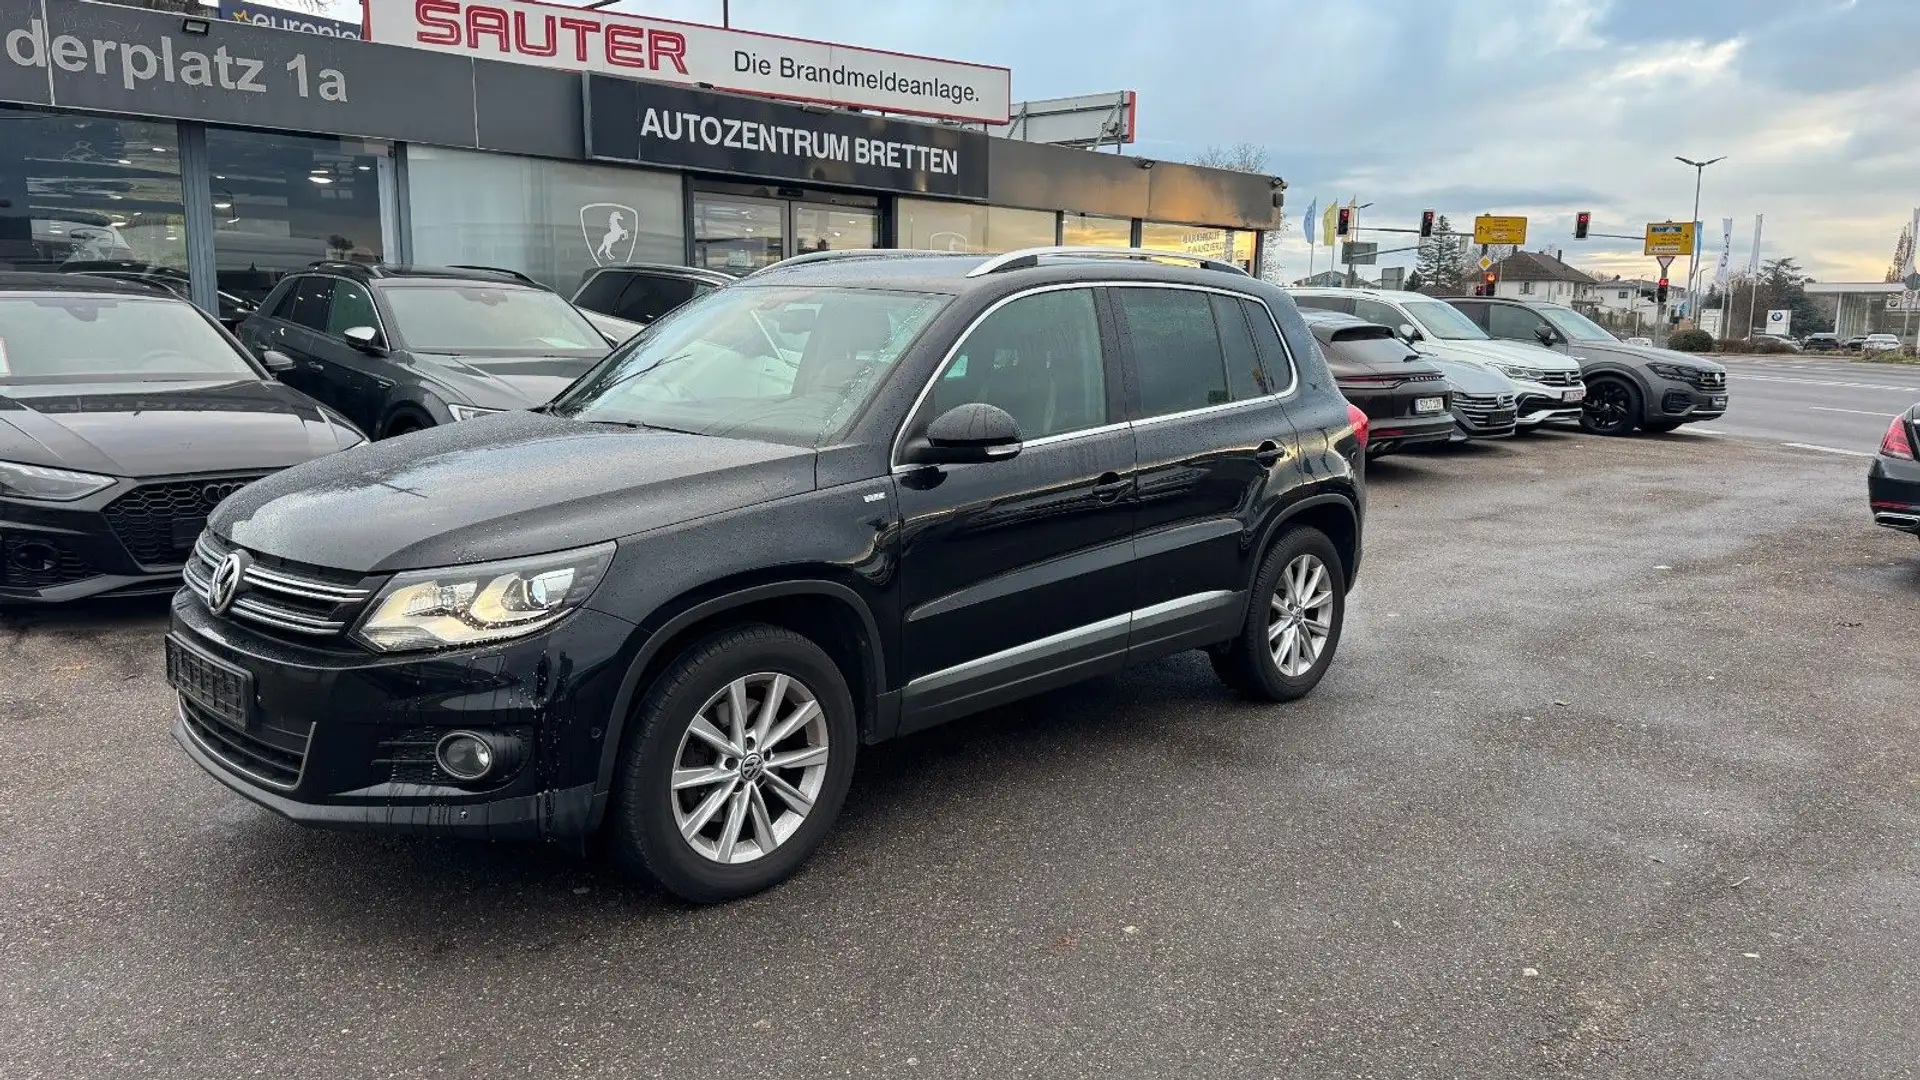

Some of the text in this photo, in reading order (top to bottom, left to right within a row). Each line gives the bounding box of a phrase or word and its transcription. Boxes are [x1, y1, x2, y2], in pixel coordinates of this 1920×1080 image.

[5, 20, 347, 102] derplatz 1a
[415, 0, 689, 75] SAUTER
[734, 50, 981, 105] Die Brandmeldeanlage.
[640, 106, 958, 175] AUTOZENTRUM BRETTEN
